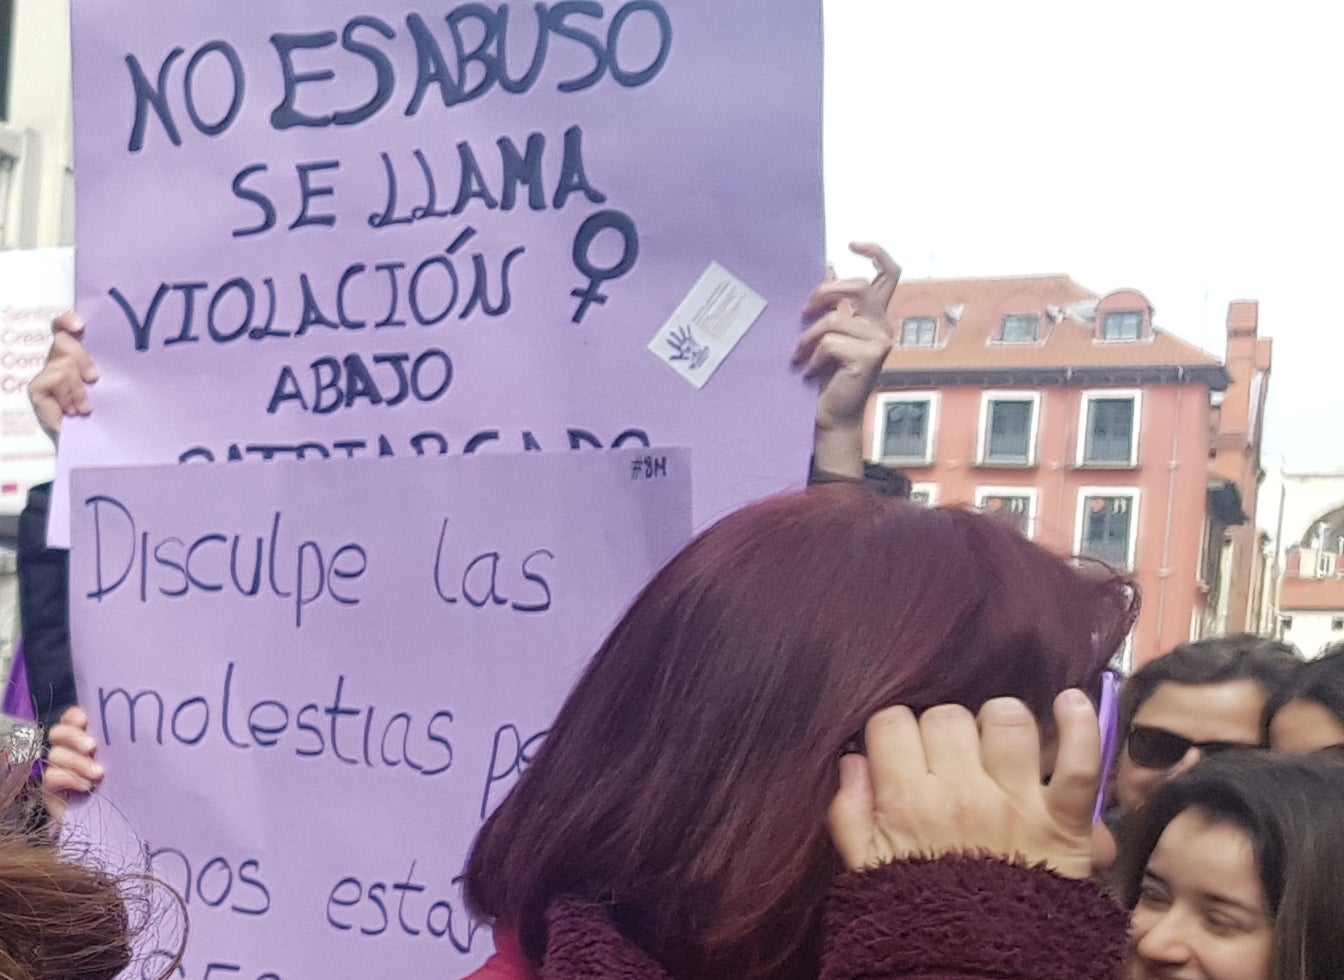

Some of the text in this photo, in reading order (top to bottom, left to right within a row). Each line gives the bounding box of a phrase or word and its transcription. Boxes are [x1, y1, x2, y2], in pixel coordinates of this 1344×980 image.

[125, 39, 245, 152] NO
[231, 124, 607, 238] SE LLAMA
[108, 226, 526, 351] VIOLACIÓN
[266, 346, 454, 414] ABAJO
[85, 494, 555, 627] Disculpe las
[98, 661, 454, 776] molestias
